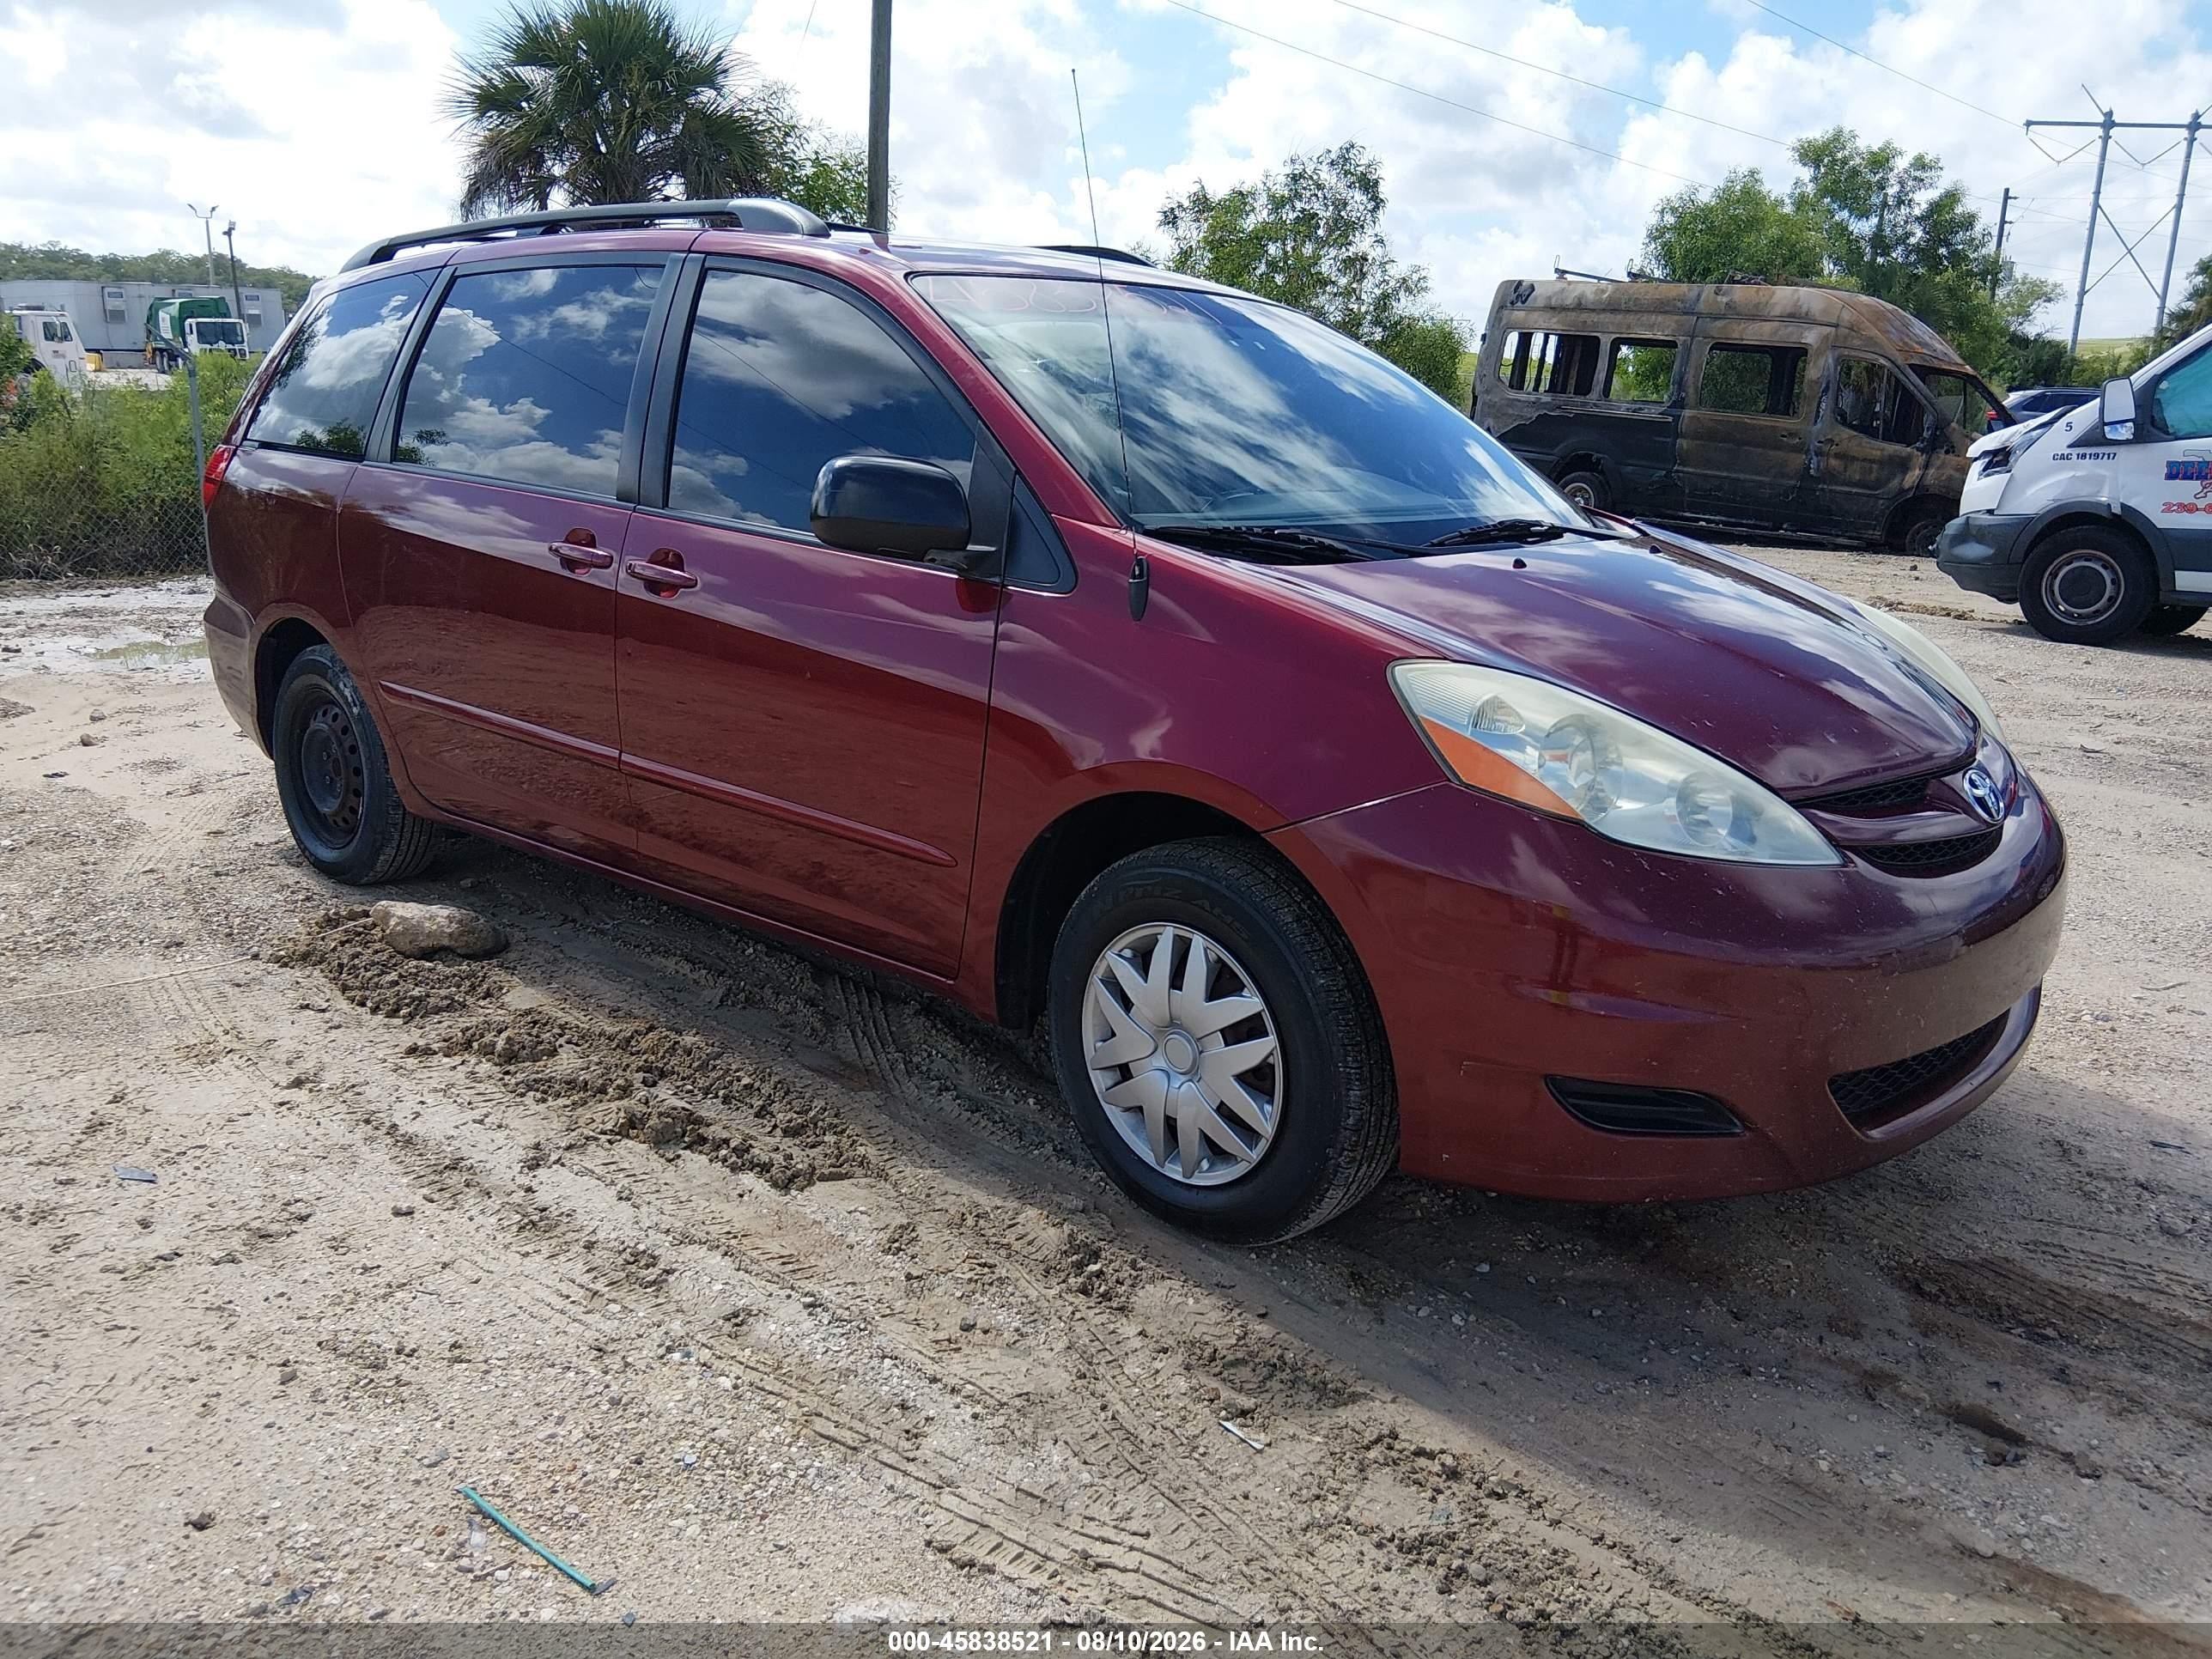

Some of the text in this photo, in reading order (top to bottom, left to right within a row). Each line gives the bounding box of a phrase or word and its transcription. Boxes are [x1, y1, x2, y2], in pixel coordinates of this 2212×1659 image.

[2064, 422, 2074, 432] 5
[2052, 452, 2117, 461] CAC 1819717
